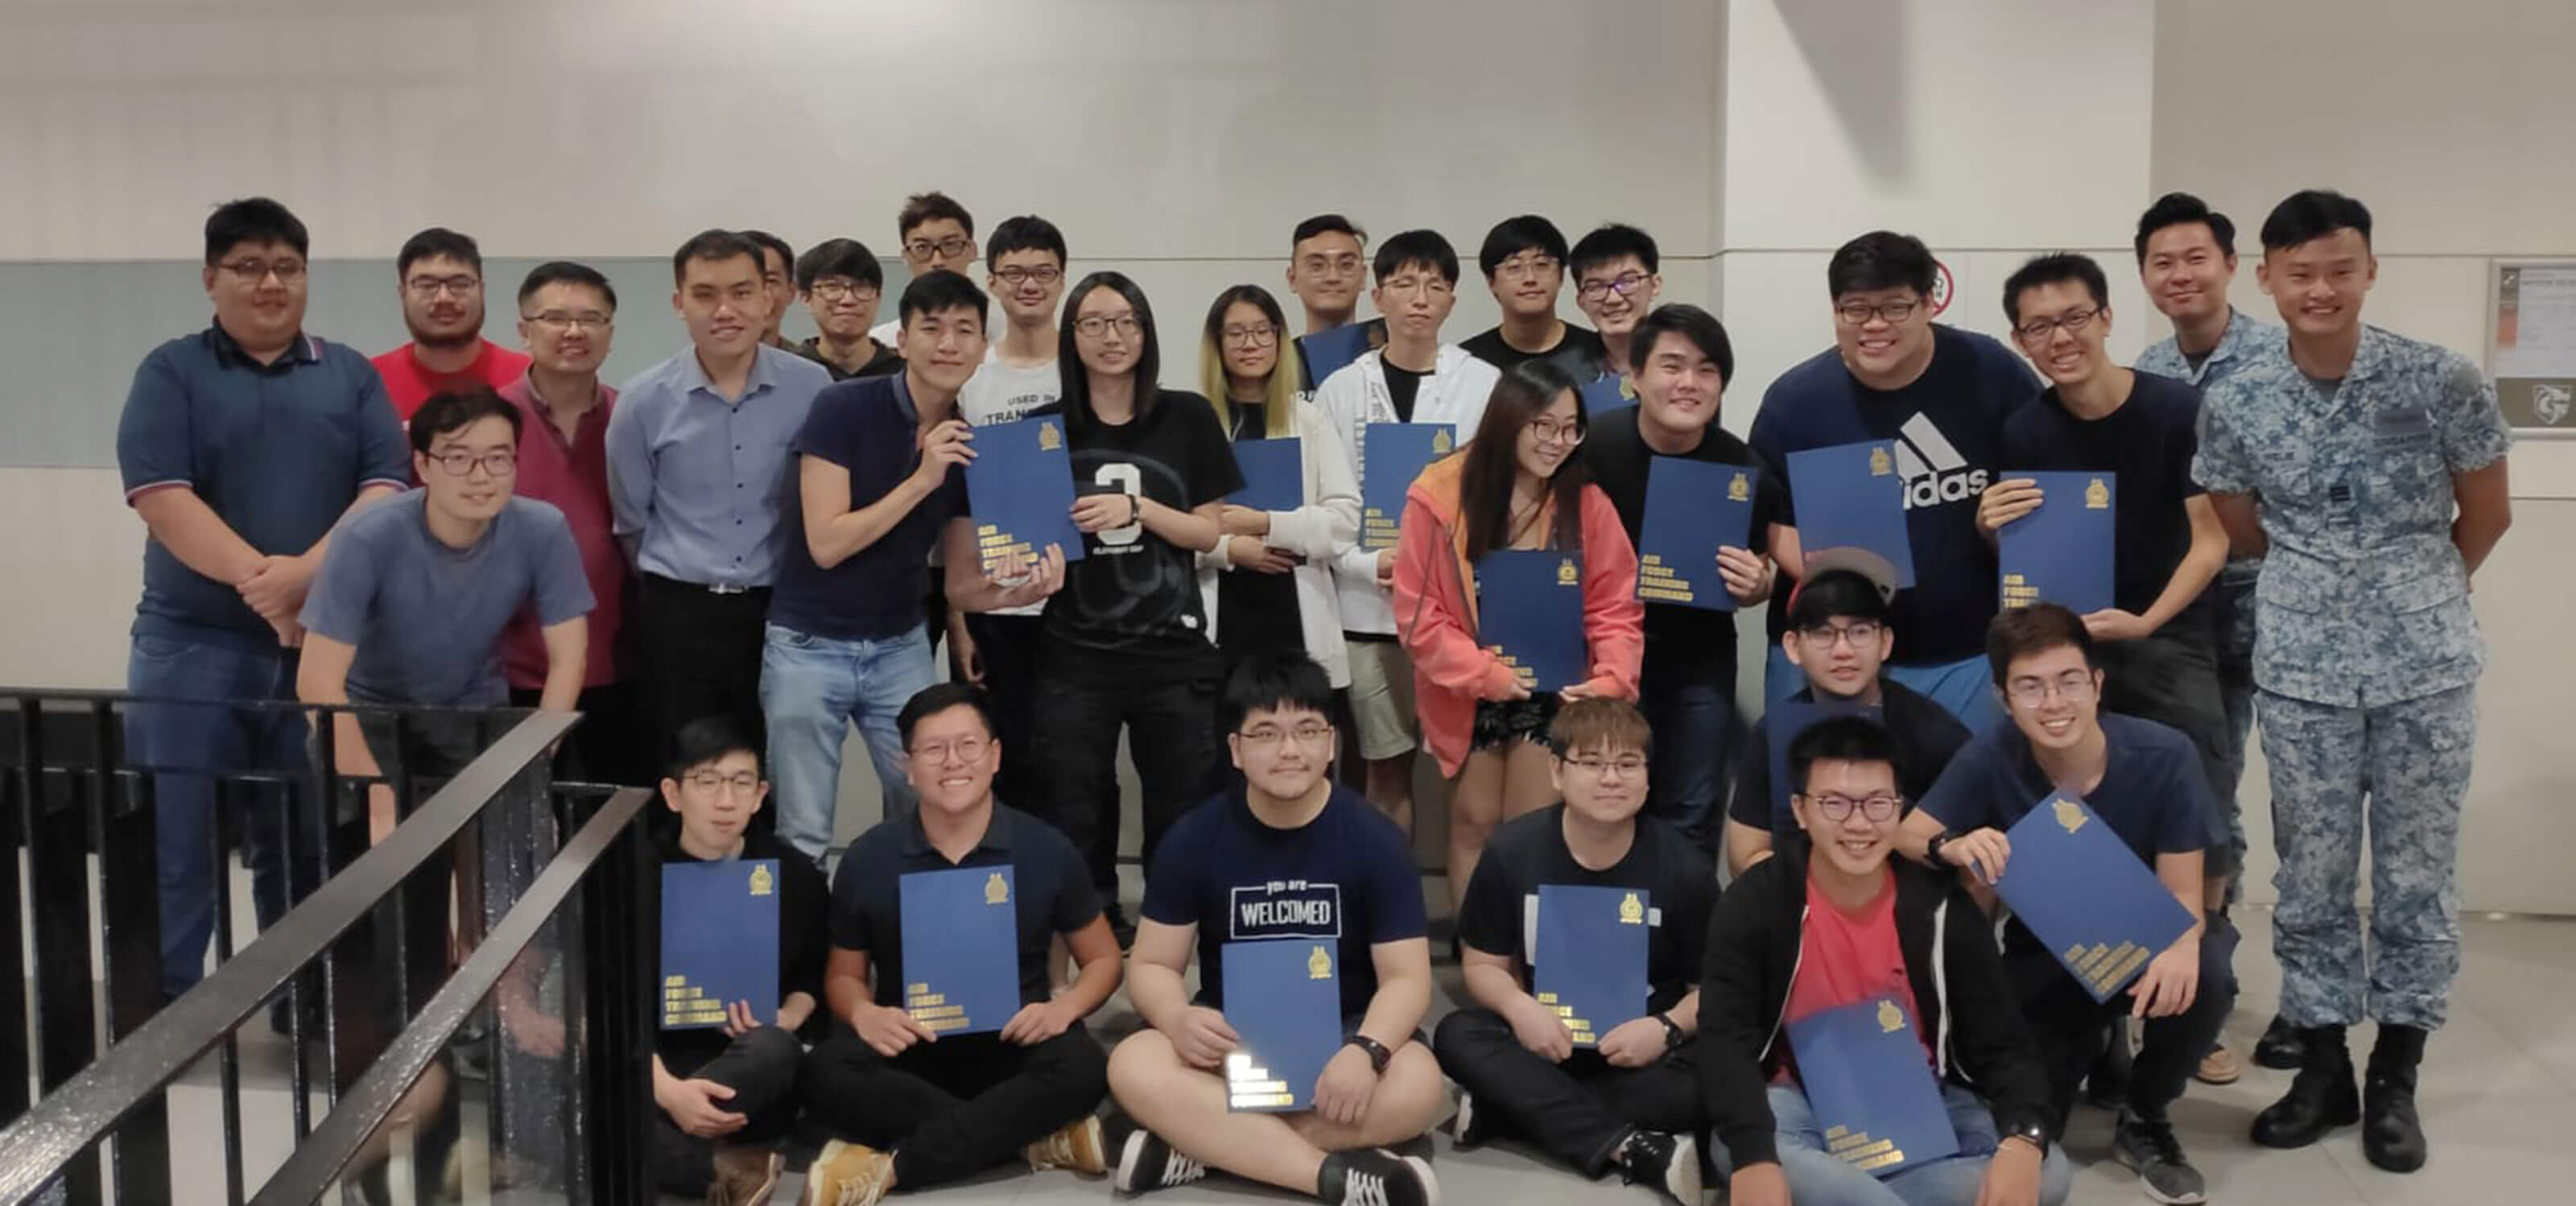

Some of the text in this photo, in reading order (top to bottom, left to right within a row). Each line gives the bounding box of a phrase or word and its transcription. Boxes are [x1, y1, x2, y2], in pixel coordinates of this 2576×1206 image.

[1007, 394, 1038, 406] USED
[1902, 469, 1988, 510] idas
[1267, 879, 1307, 895] you are
[1241, 900, 1331, 927] WELCOMED
